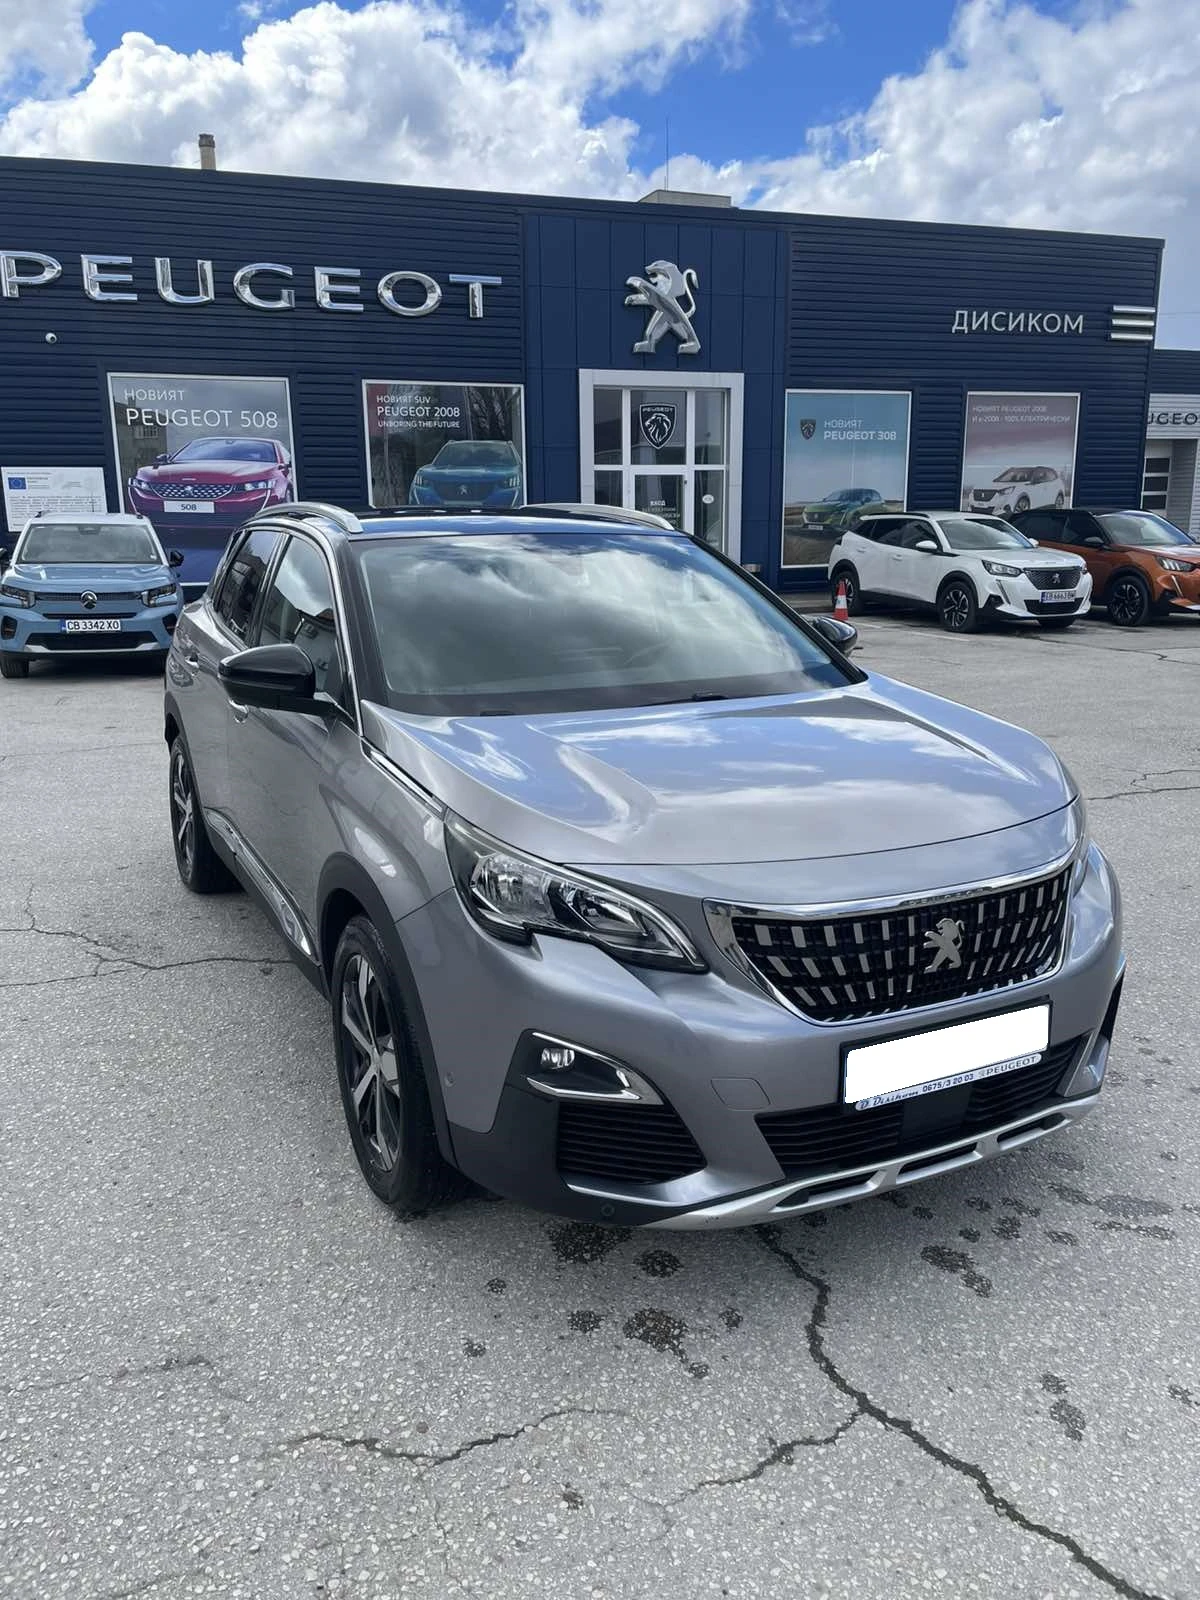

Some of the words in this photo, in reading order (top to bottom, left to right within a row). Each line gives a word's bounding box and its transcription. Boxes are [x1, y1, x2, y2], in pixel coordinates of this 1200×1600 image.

[0, 250, 502, 319] PEUGEOT
[951, 310, 1084, 334] ДИСИКОМ
[124, 388, 185, 401] НОВИЯТ
[376, 395, 412, 403] НОВИЯТ
[414, 396, 431, 404] SUV
[377, 406, 431, 417] PEUGEOT
[434, 406, 460, 417] 2008
[126, 408, 233, 428] PEUGEOT
[240, 410, 279, 428] 508
[823, 419, 863, 429] НОВИЯТ
[823, 430, 877, 440] PEUGEOT
[877, 431, 897, 440] 308
[180, 503, 197, 511] 508
[82, 621, 105, 630] 3342
[922, 1079, 951, 1092] 0675/3
[952, 1076, 963, 1085] 20
[964, 1073, 974, 1082] 03
[986, 1055, 1037, 1076] PEUGEOT
